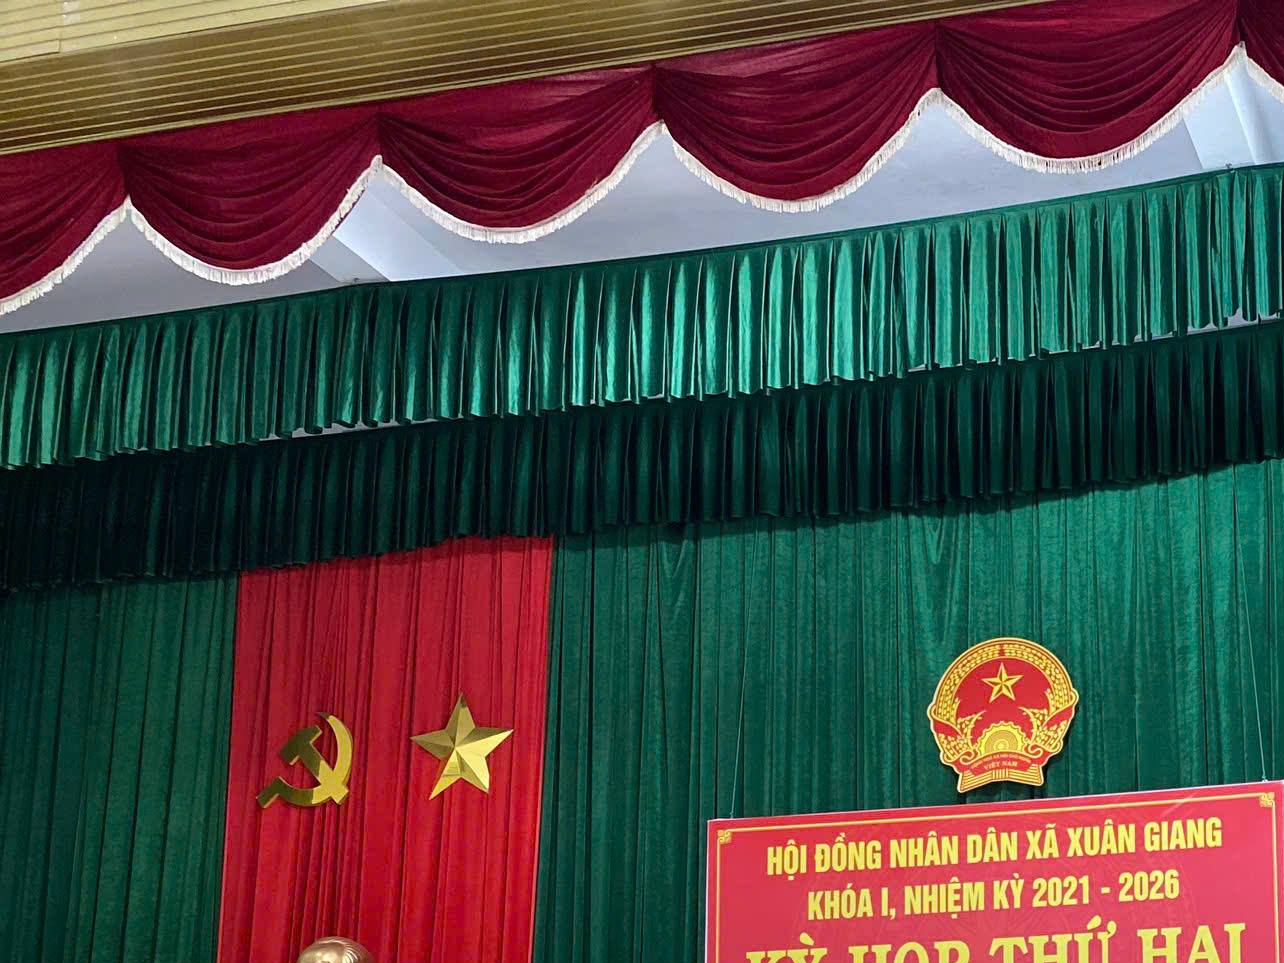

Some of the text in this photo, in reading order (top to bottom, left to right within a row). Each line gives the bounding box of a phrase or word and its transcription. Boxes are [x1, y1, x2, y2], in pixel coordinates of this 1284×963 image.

[767, 816, 1223, 881] HỘI ĐỒNG NHÂN DÂN XÃ XUÂN GIANG
[807, 884, 874, 921] KHÓA
[880, 887, 897, 920] I,
[903, 877, 986, 920] NHIỆM
[992, 872, 1025, 910] KỲ
[1032, 875, 1090, 908] 2021
[1118, 868, 1180, 902] 2026
